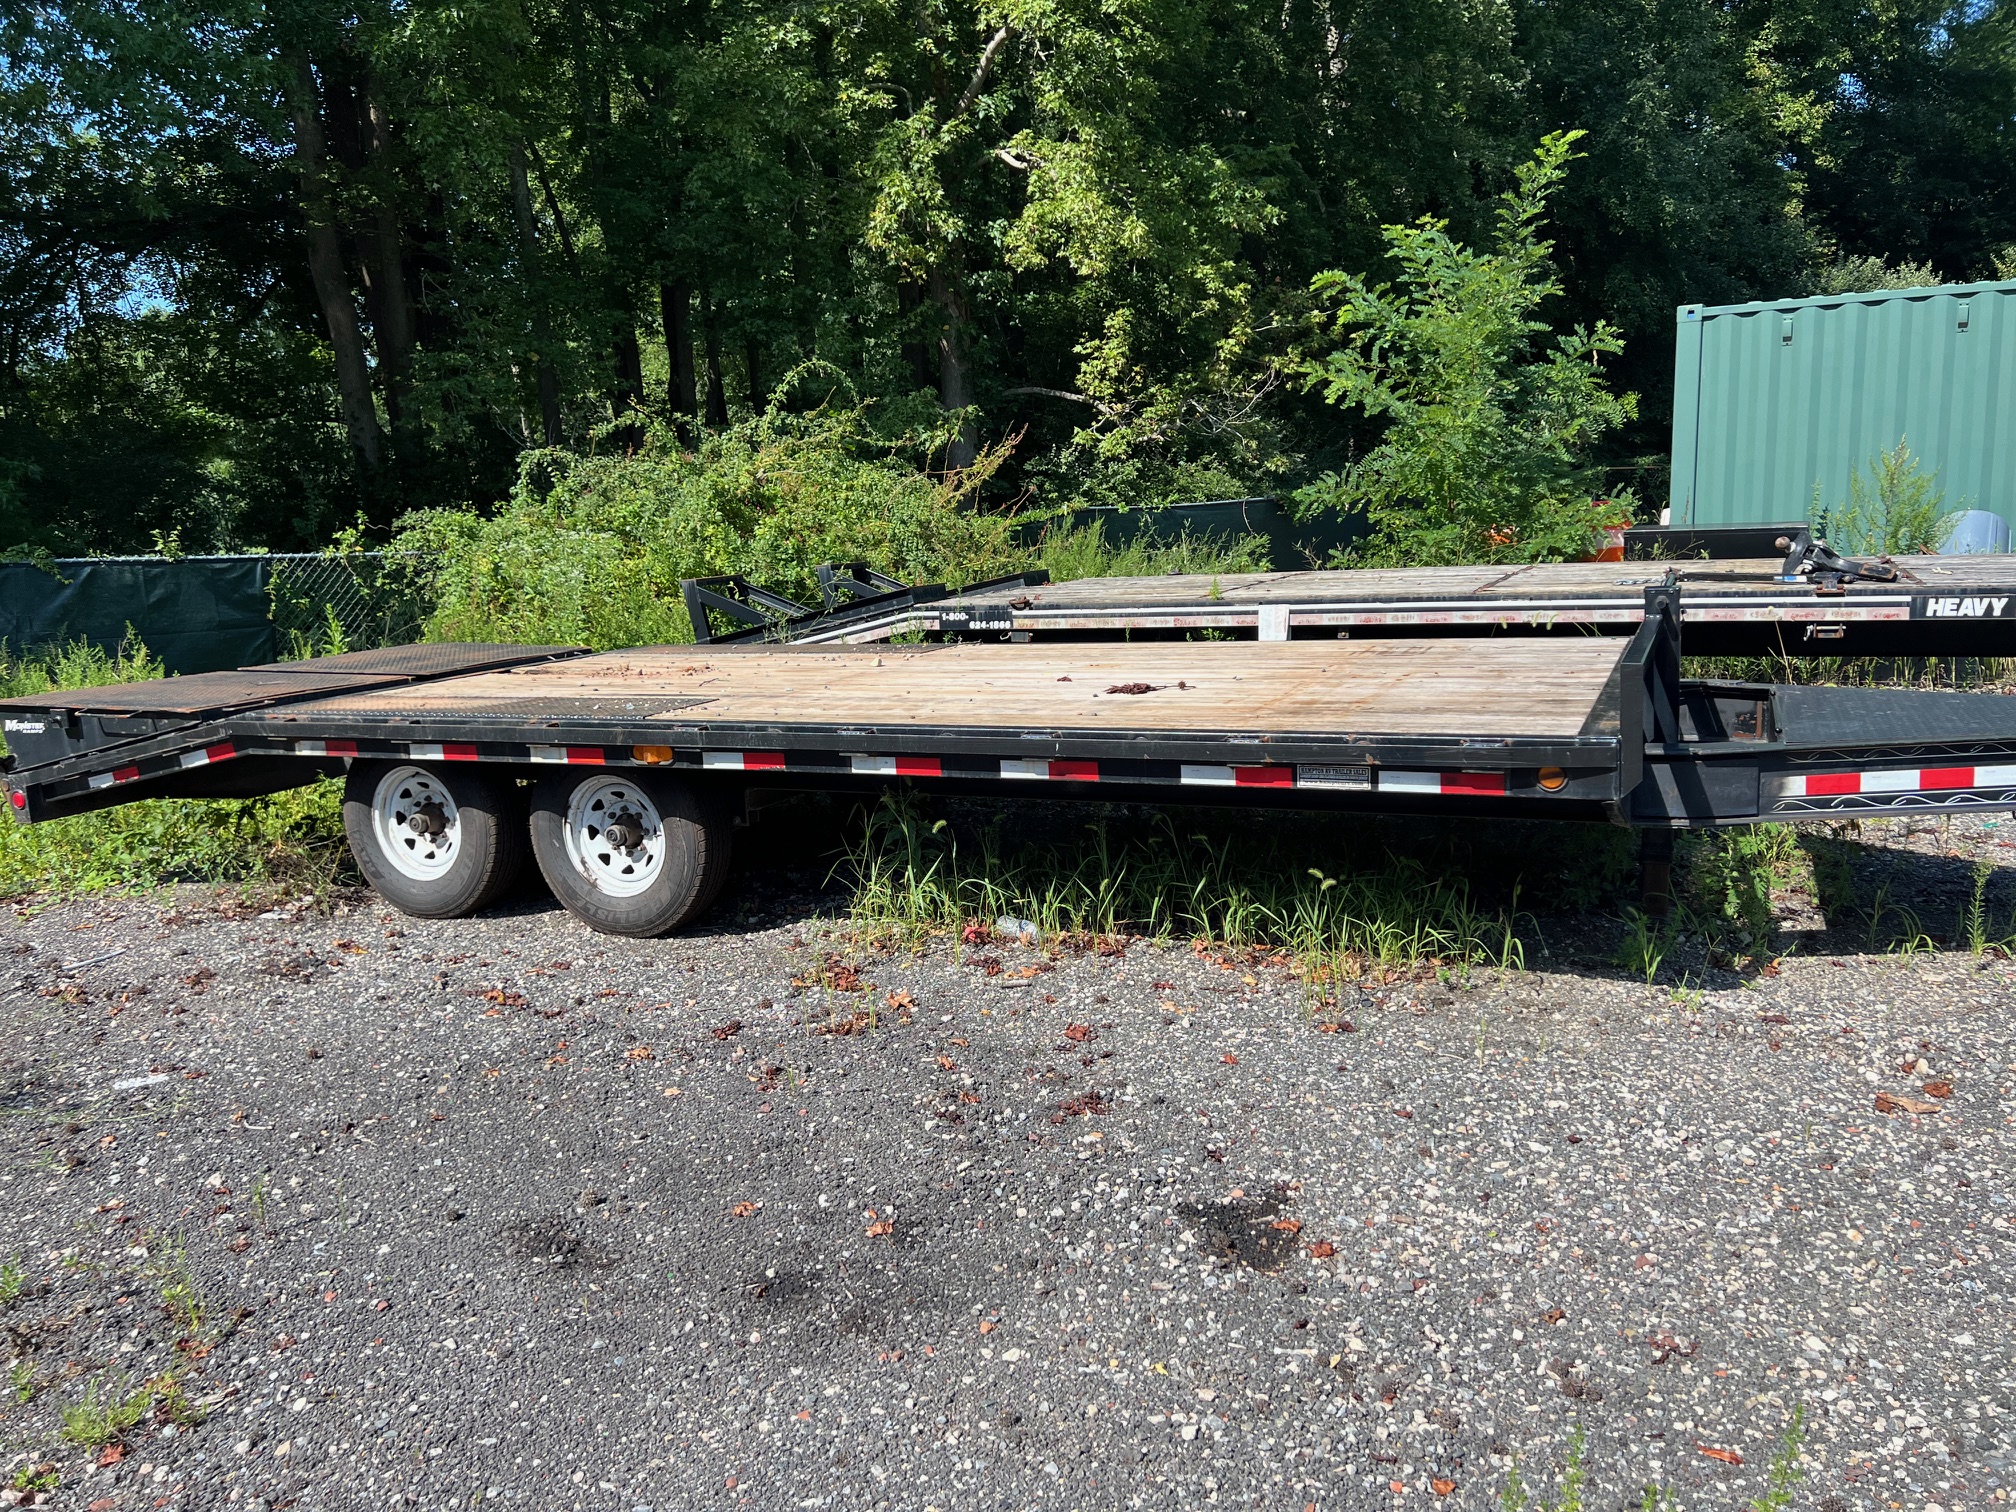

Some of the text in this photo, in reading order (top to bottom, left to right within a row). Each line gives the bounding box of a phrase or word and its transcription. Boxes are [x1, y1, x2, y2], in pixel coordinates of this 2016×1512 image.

[1926, 598, 2009, 617] HEAVY
[941, 612, 969, 620] 1-800-
[1300, 767, 1324, 775] HAMPTON
